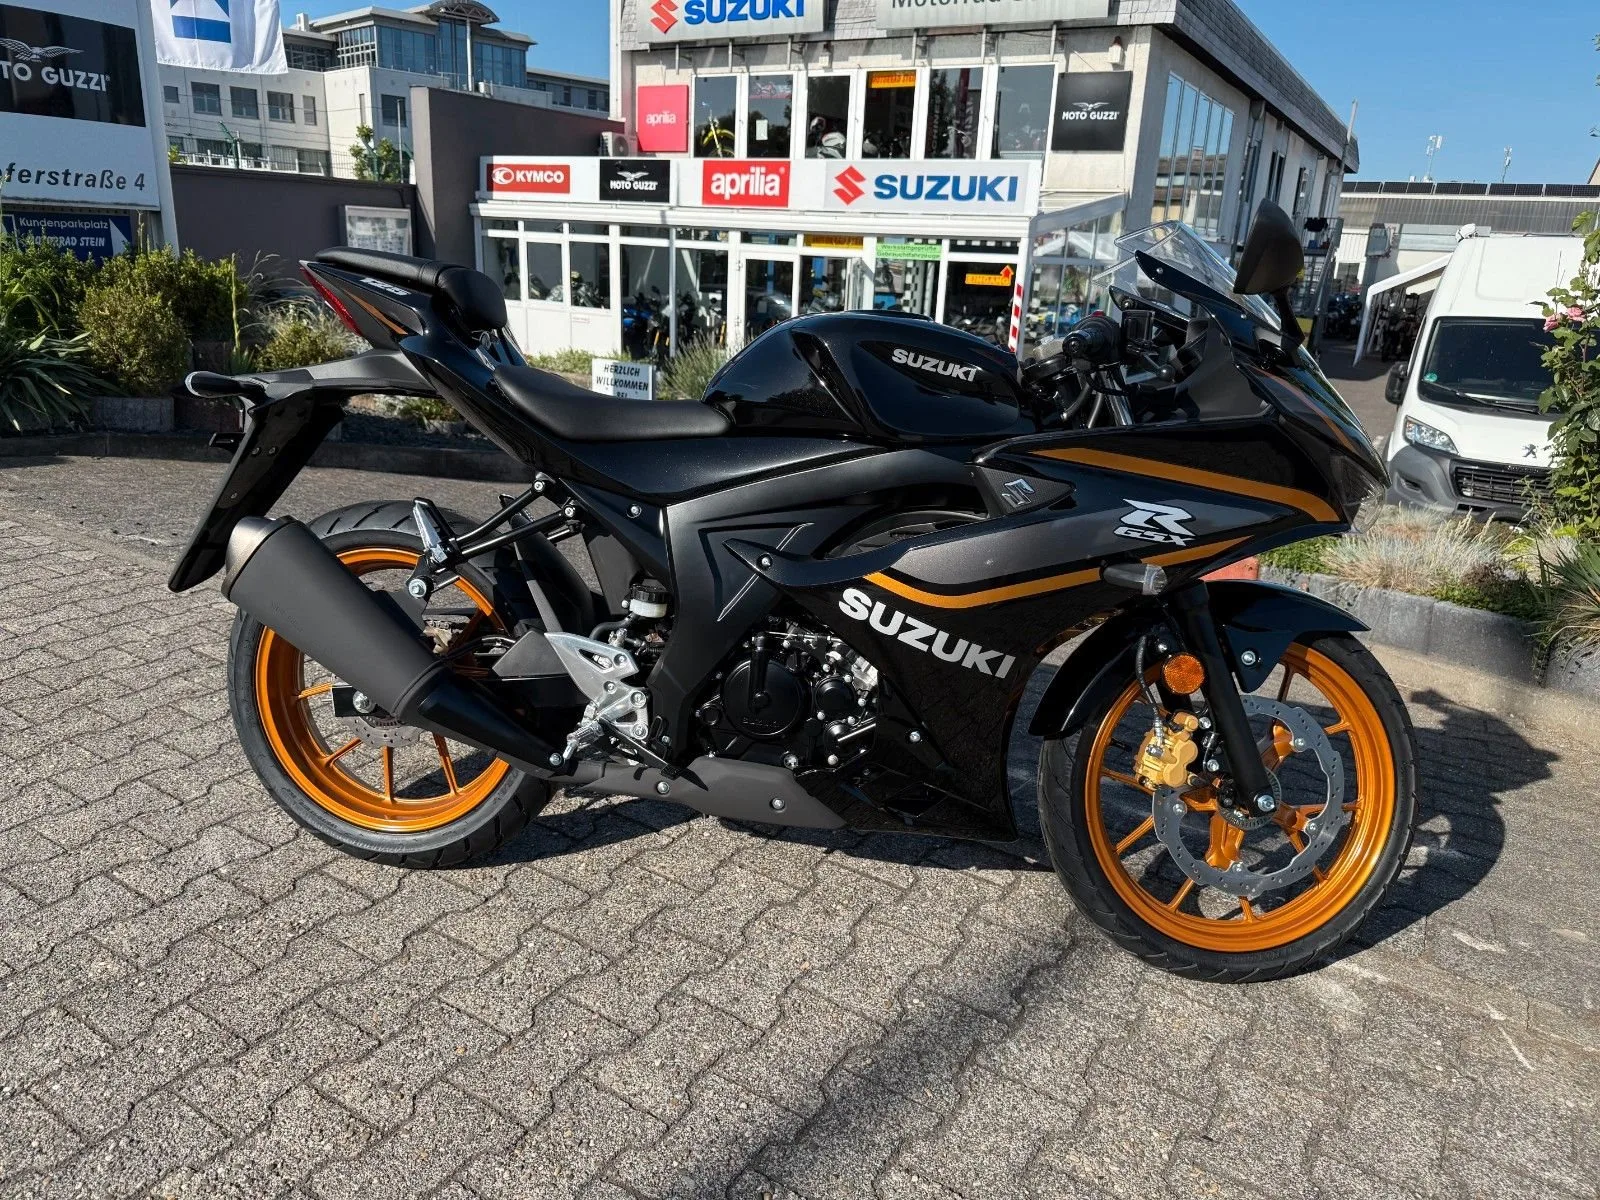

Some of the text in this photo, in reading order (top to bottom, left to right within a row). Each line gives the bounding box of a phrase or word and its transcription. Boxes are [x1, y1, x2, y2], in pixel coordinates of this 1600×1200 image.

[684, 0, 805, 25] SUZUKI
[41, 66, 107, 92] GUZZI
[646, 111, 677, 126] aprilia
[1062, 111, 1118, 120] MOTO GUZZI
[0, 162, 145, 191] ferstraße 4
[515, 170, 565, 184] KYMCO
[710, 167, 781, 199] aprilia
[610, 181, 658, 190] MOTO GUZZI
[875, 174, 1018, 202] SUZUKI
[20, 217, 108, 230] Kundenparkplatz
[79, 236, 105, 247] STEIN
[604, 364, 641, 377] HERZLICH
[891, 348, 977, 382] SUZUKI
[596, 375, 649, 392] WILLKOMMEN
[838, 588, 1016, 679] SUZUKI
